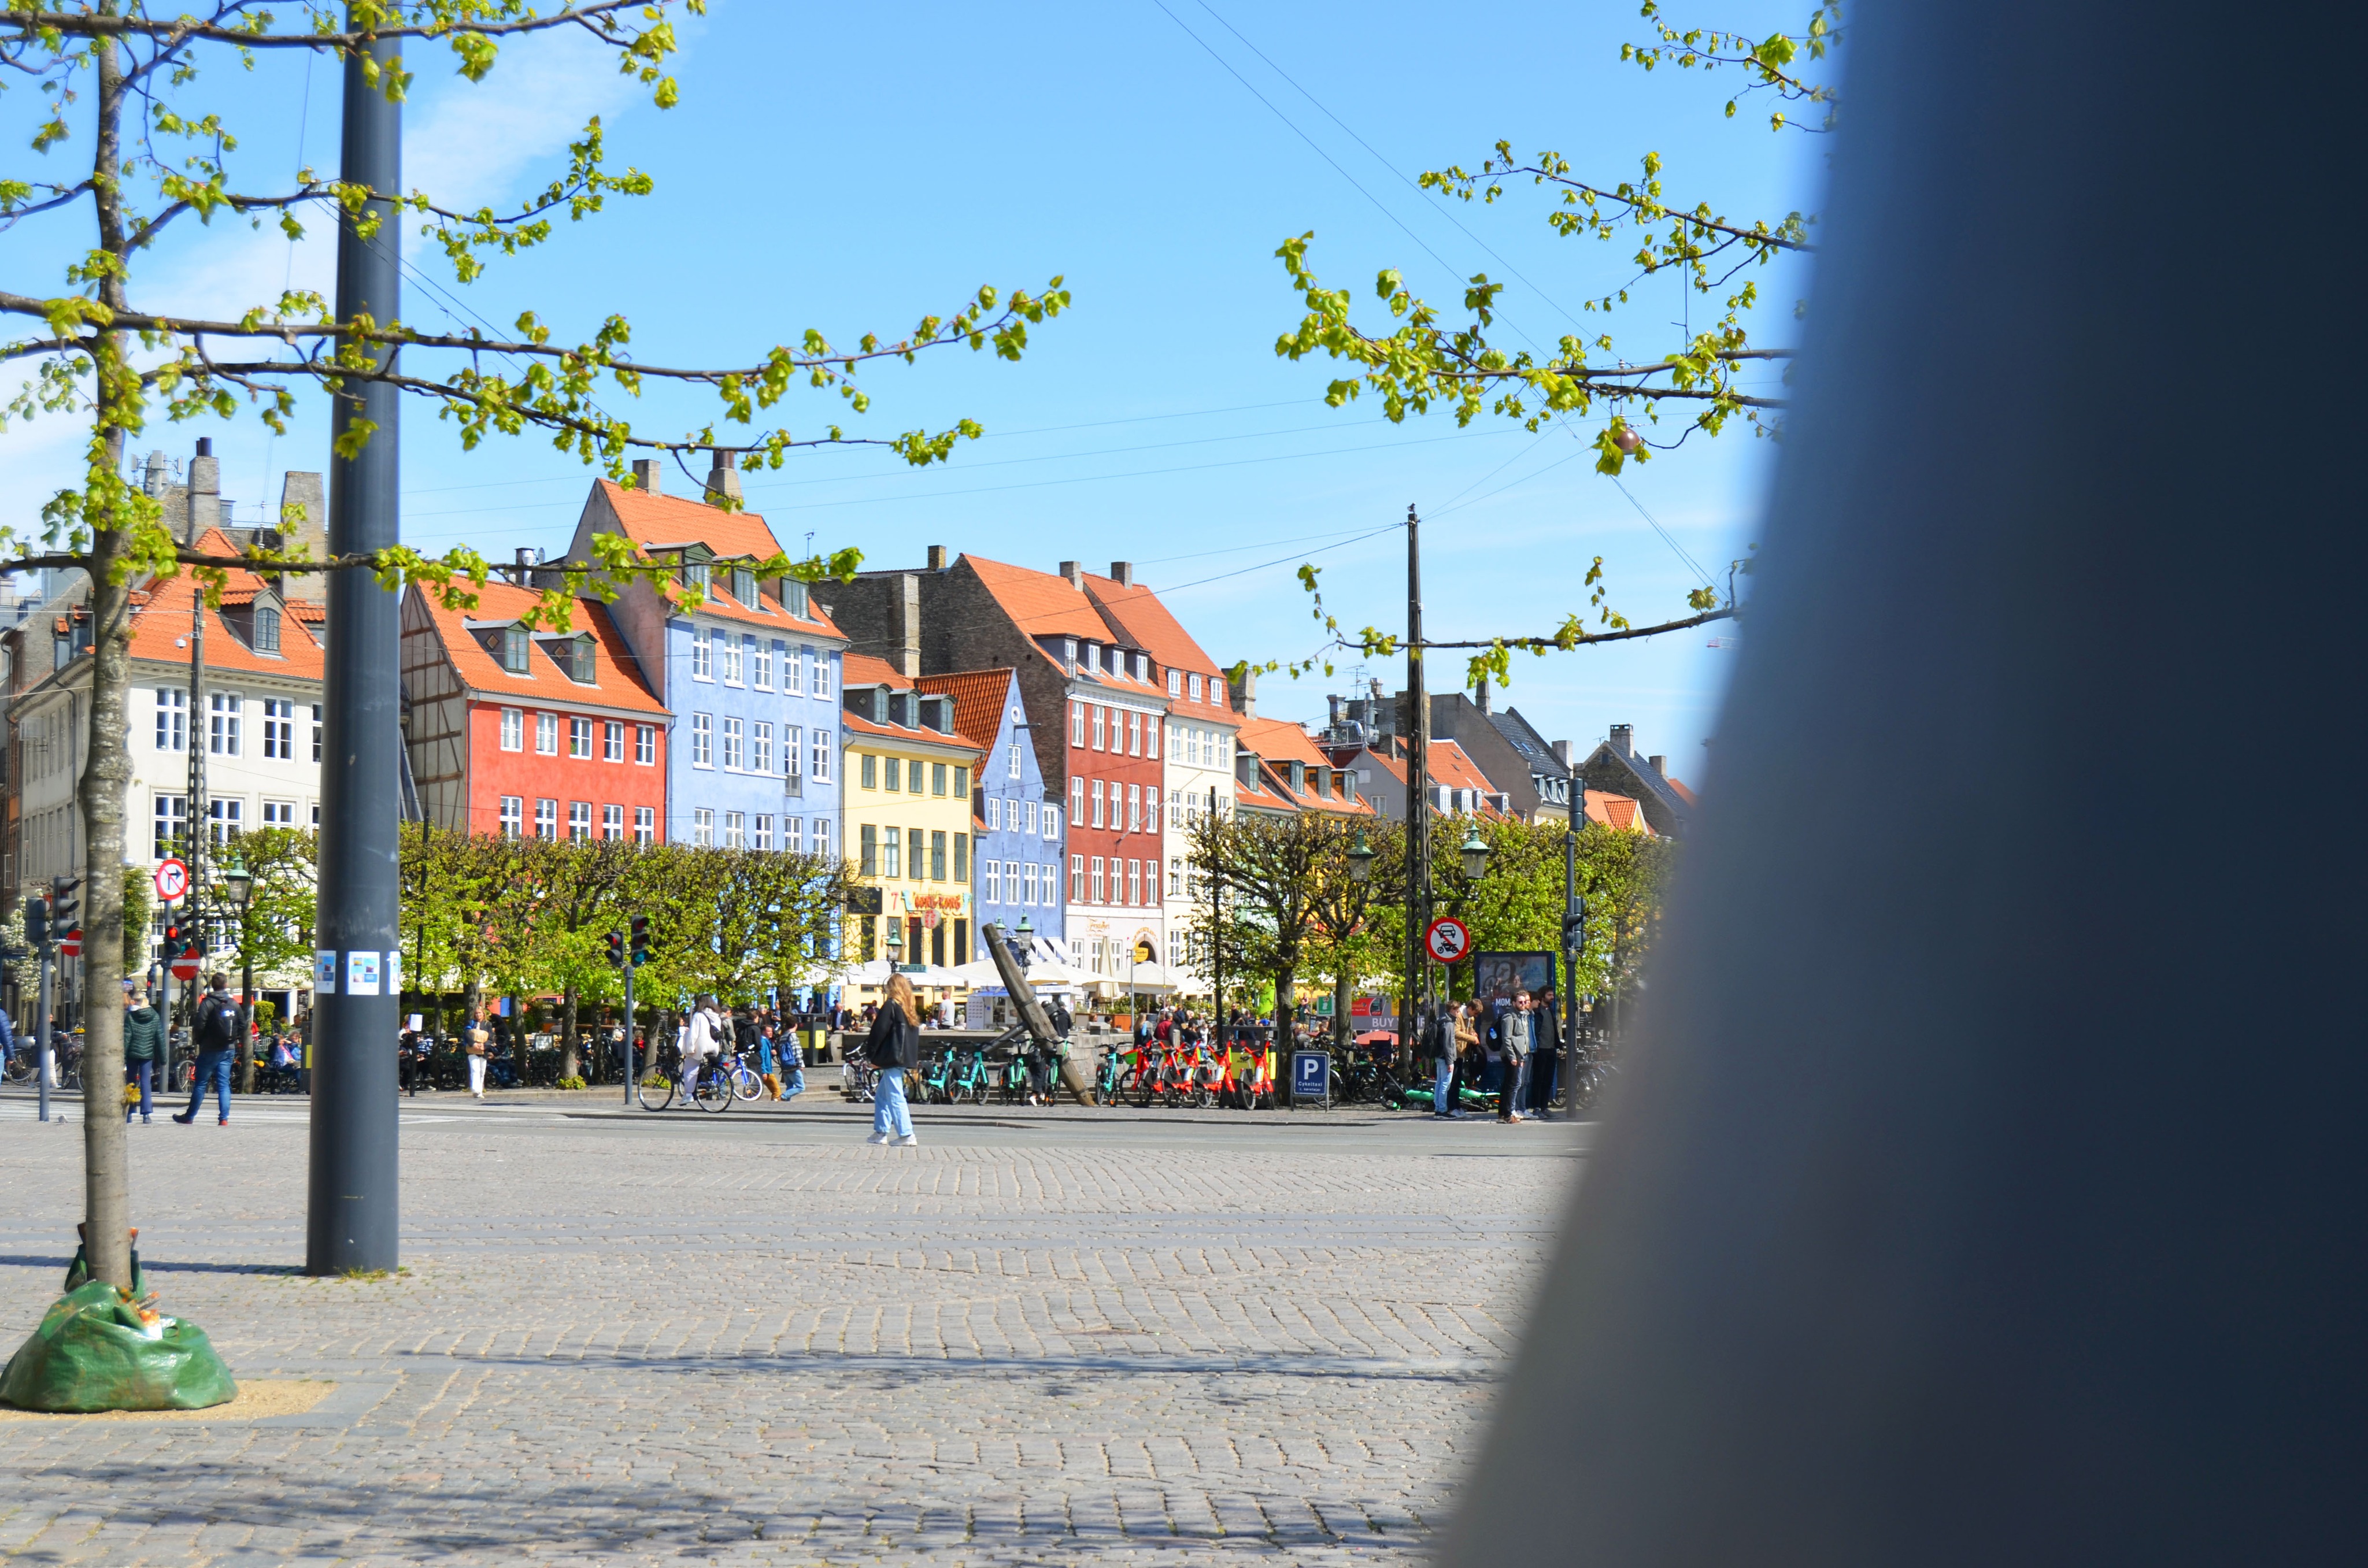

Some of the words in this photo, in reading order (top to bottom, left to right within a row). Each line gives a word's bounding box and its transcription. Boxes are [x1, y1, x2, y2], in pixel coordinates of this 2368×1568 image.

[891, 892, 899, 910] 7
[1372, 1018, 1393, 1027] BUY
[1304, 1059, 1319, 1080] P
